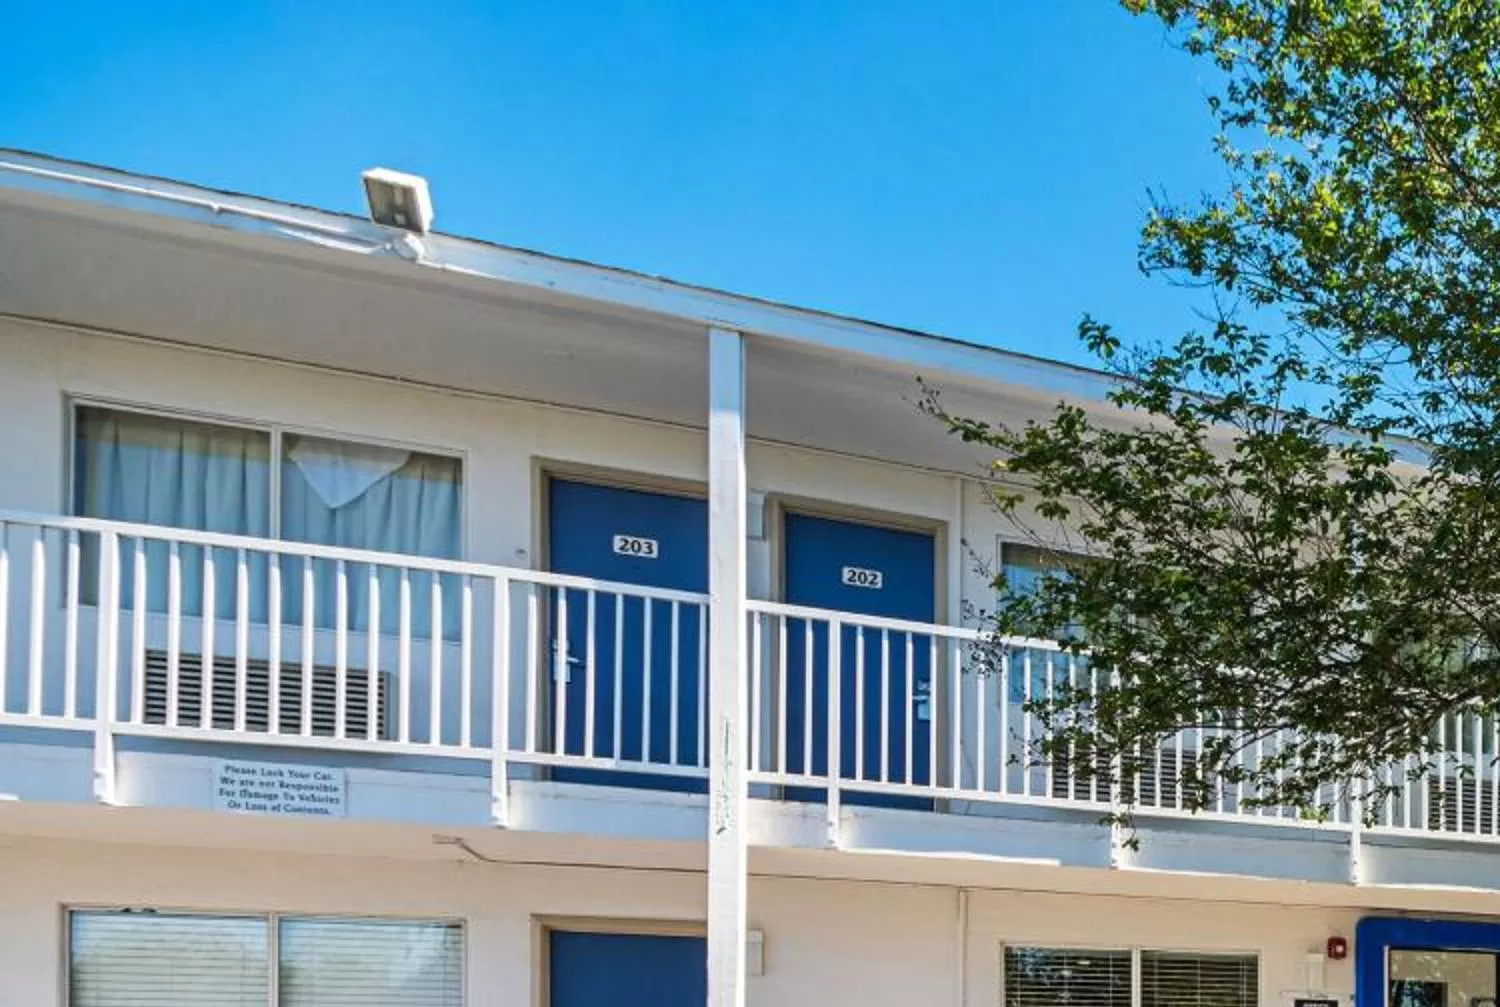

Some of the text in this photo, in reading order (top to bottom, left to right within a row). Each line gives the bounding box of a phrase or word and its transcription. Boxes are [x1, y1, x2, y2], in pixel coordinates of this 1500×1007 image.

[619, 537, 653, 555] 203
[847, 569, 878, 586] 202
[220, 776, 235, 785] We
[287, 769, 311, 779] Your
